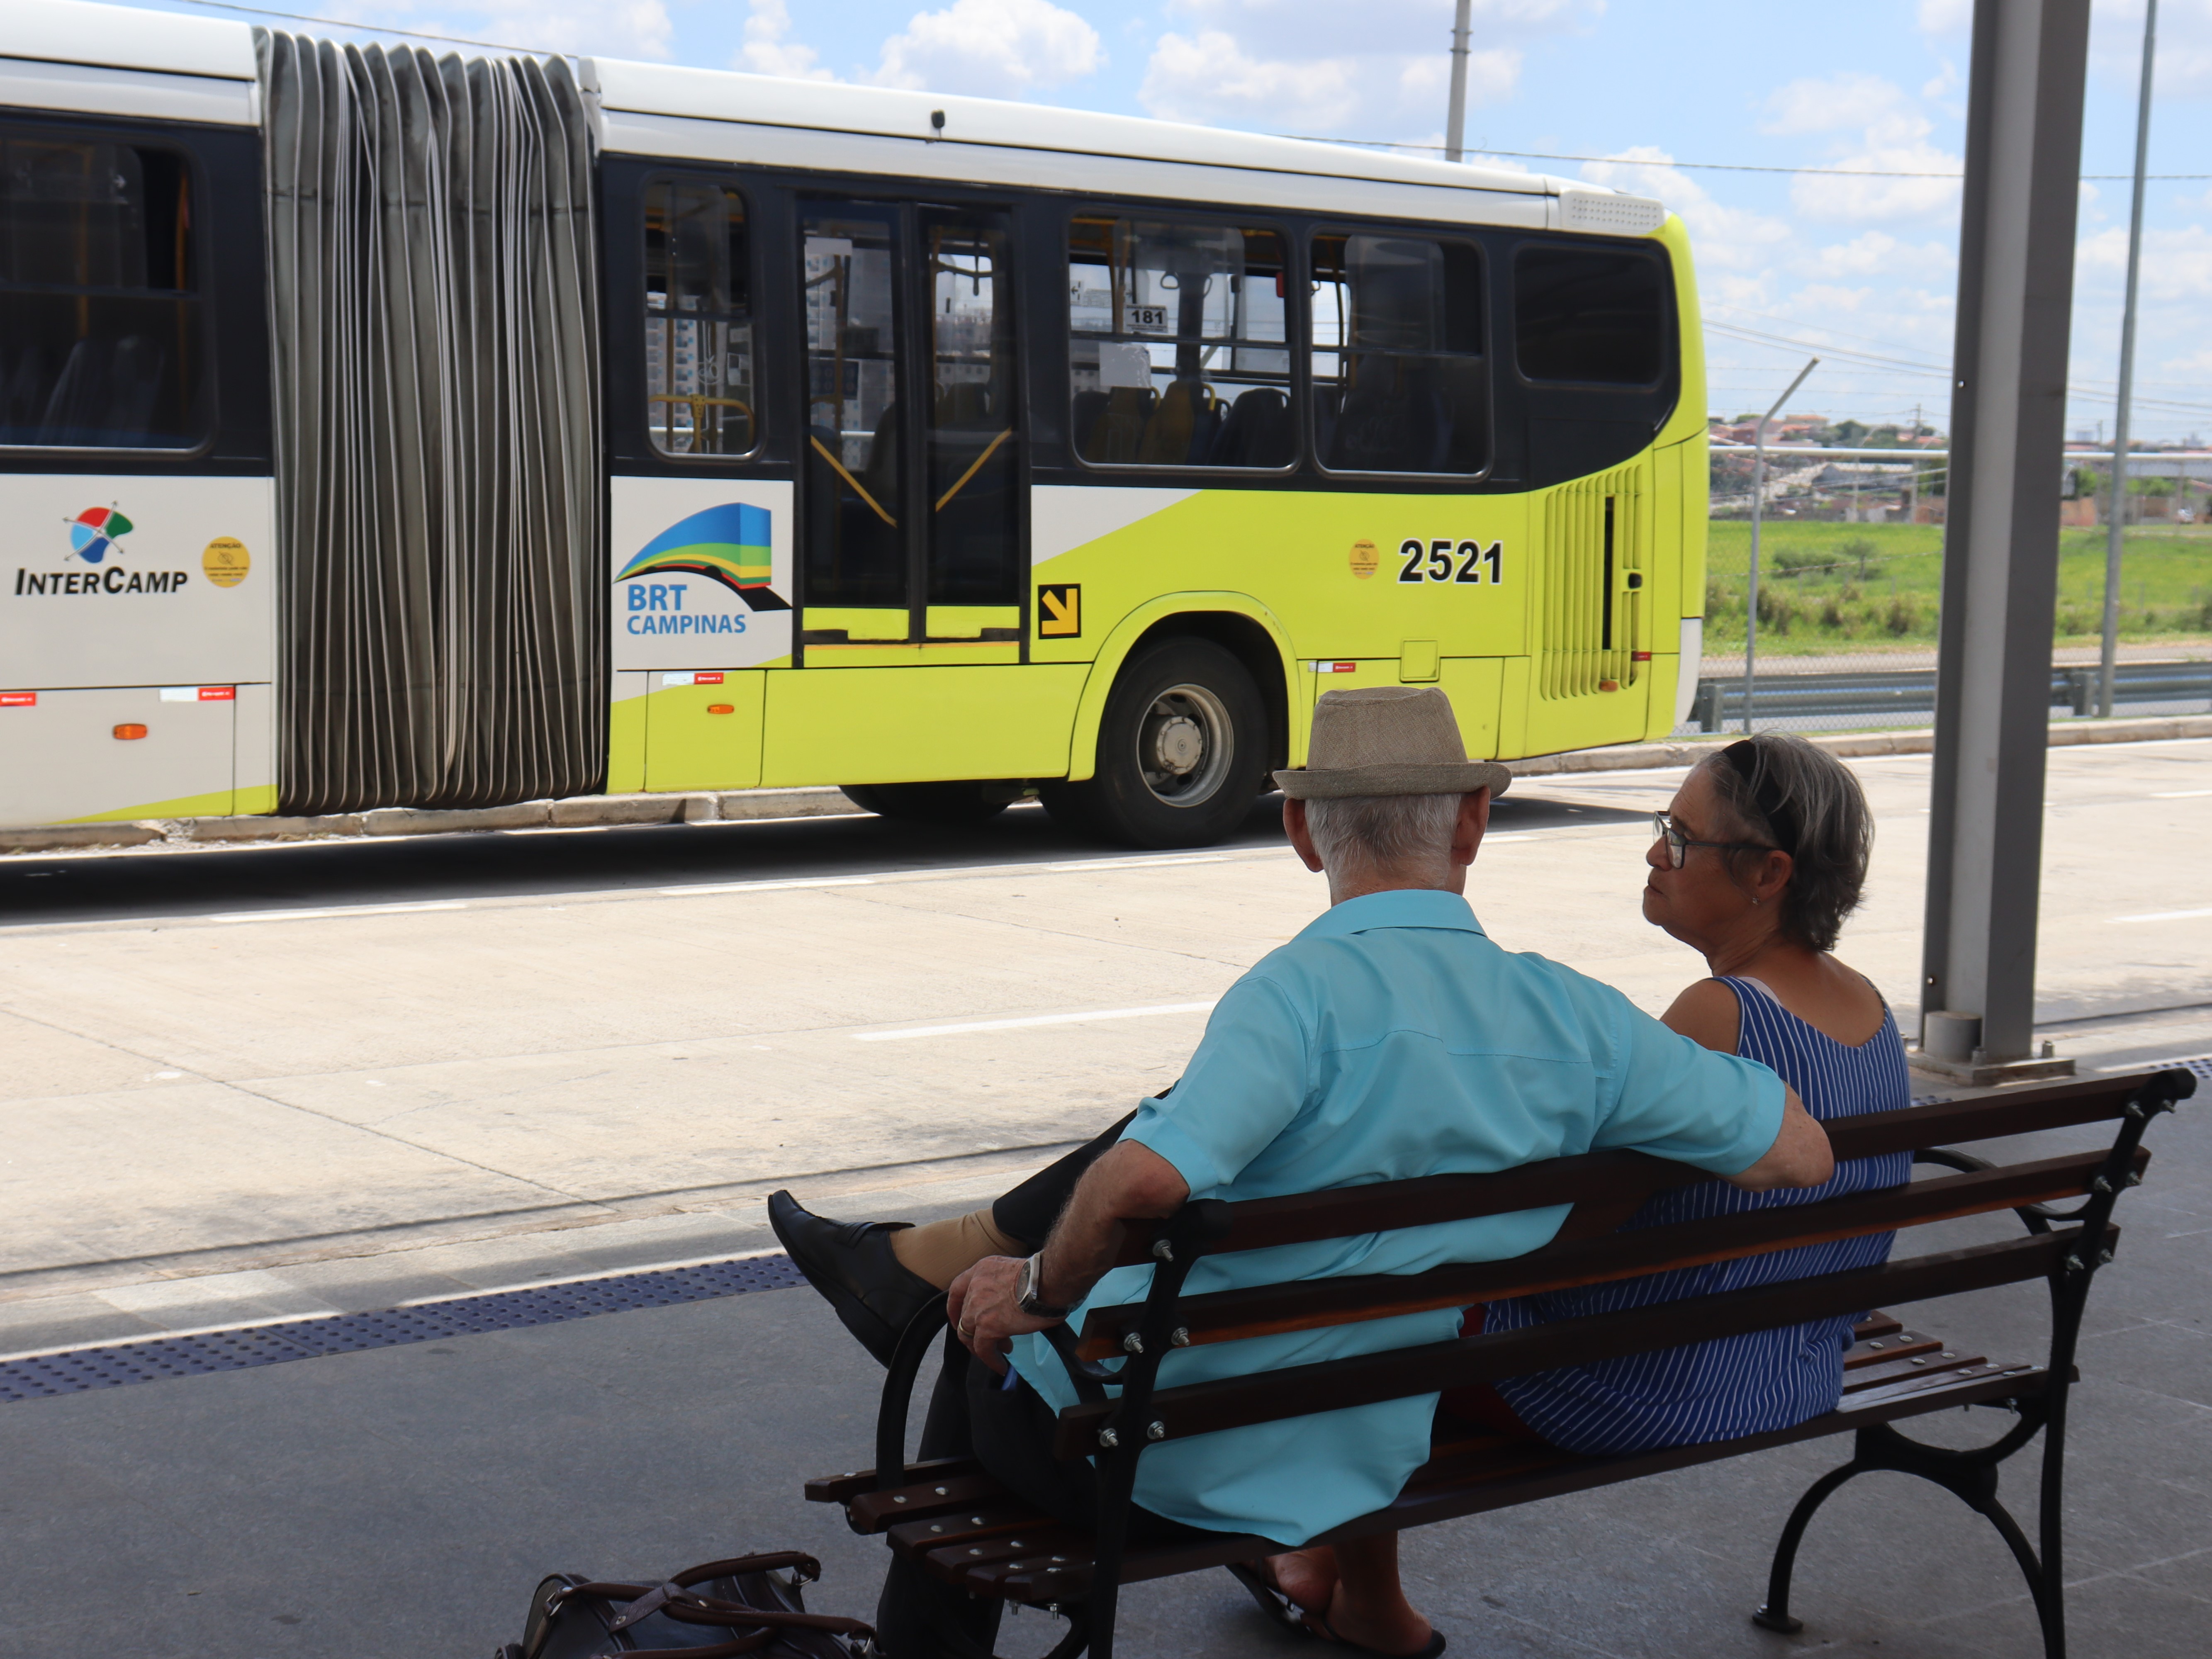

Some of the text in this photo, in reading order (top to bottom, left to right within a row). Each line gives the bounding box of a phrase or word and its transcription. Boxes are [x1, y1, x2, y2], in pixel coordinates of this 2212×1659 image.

[1132, 309, 1163, 324] 181
[1398, 538, 1503, 584] 2521
[628, 584, 687, 611] BRT
[627, 614, 746, 635] CAMPINAS
